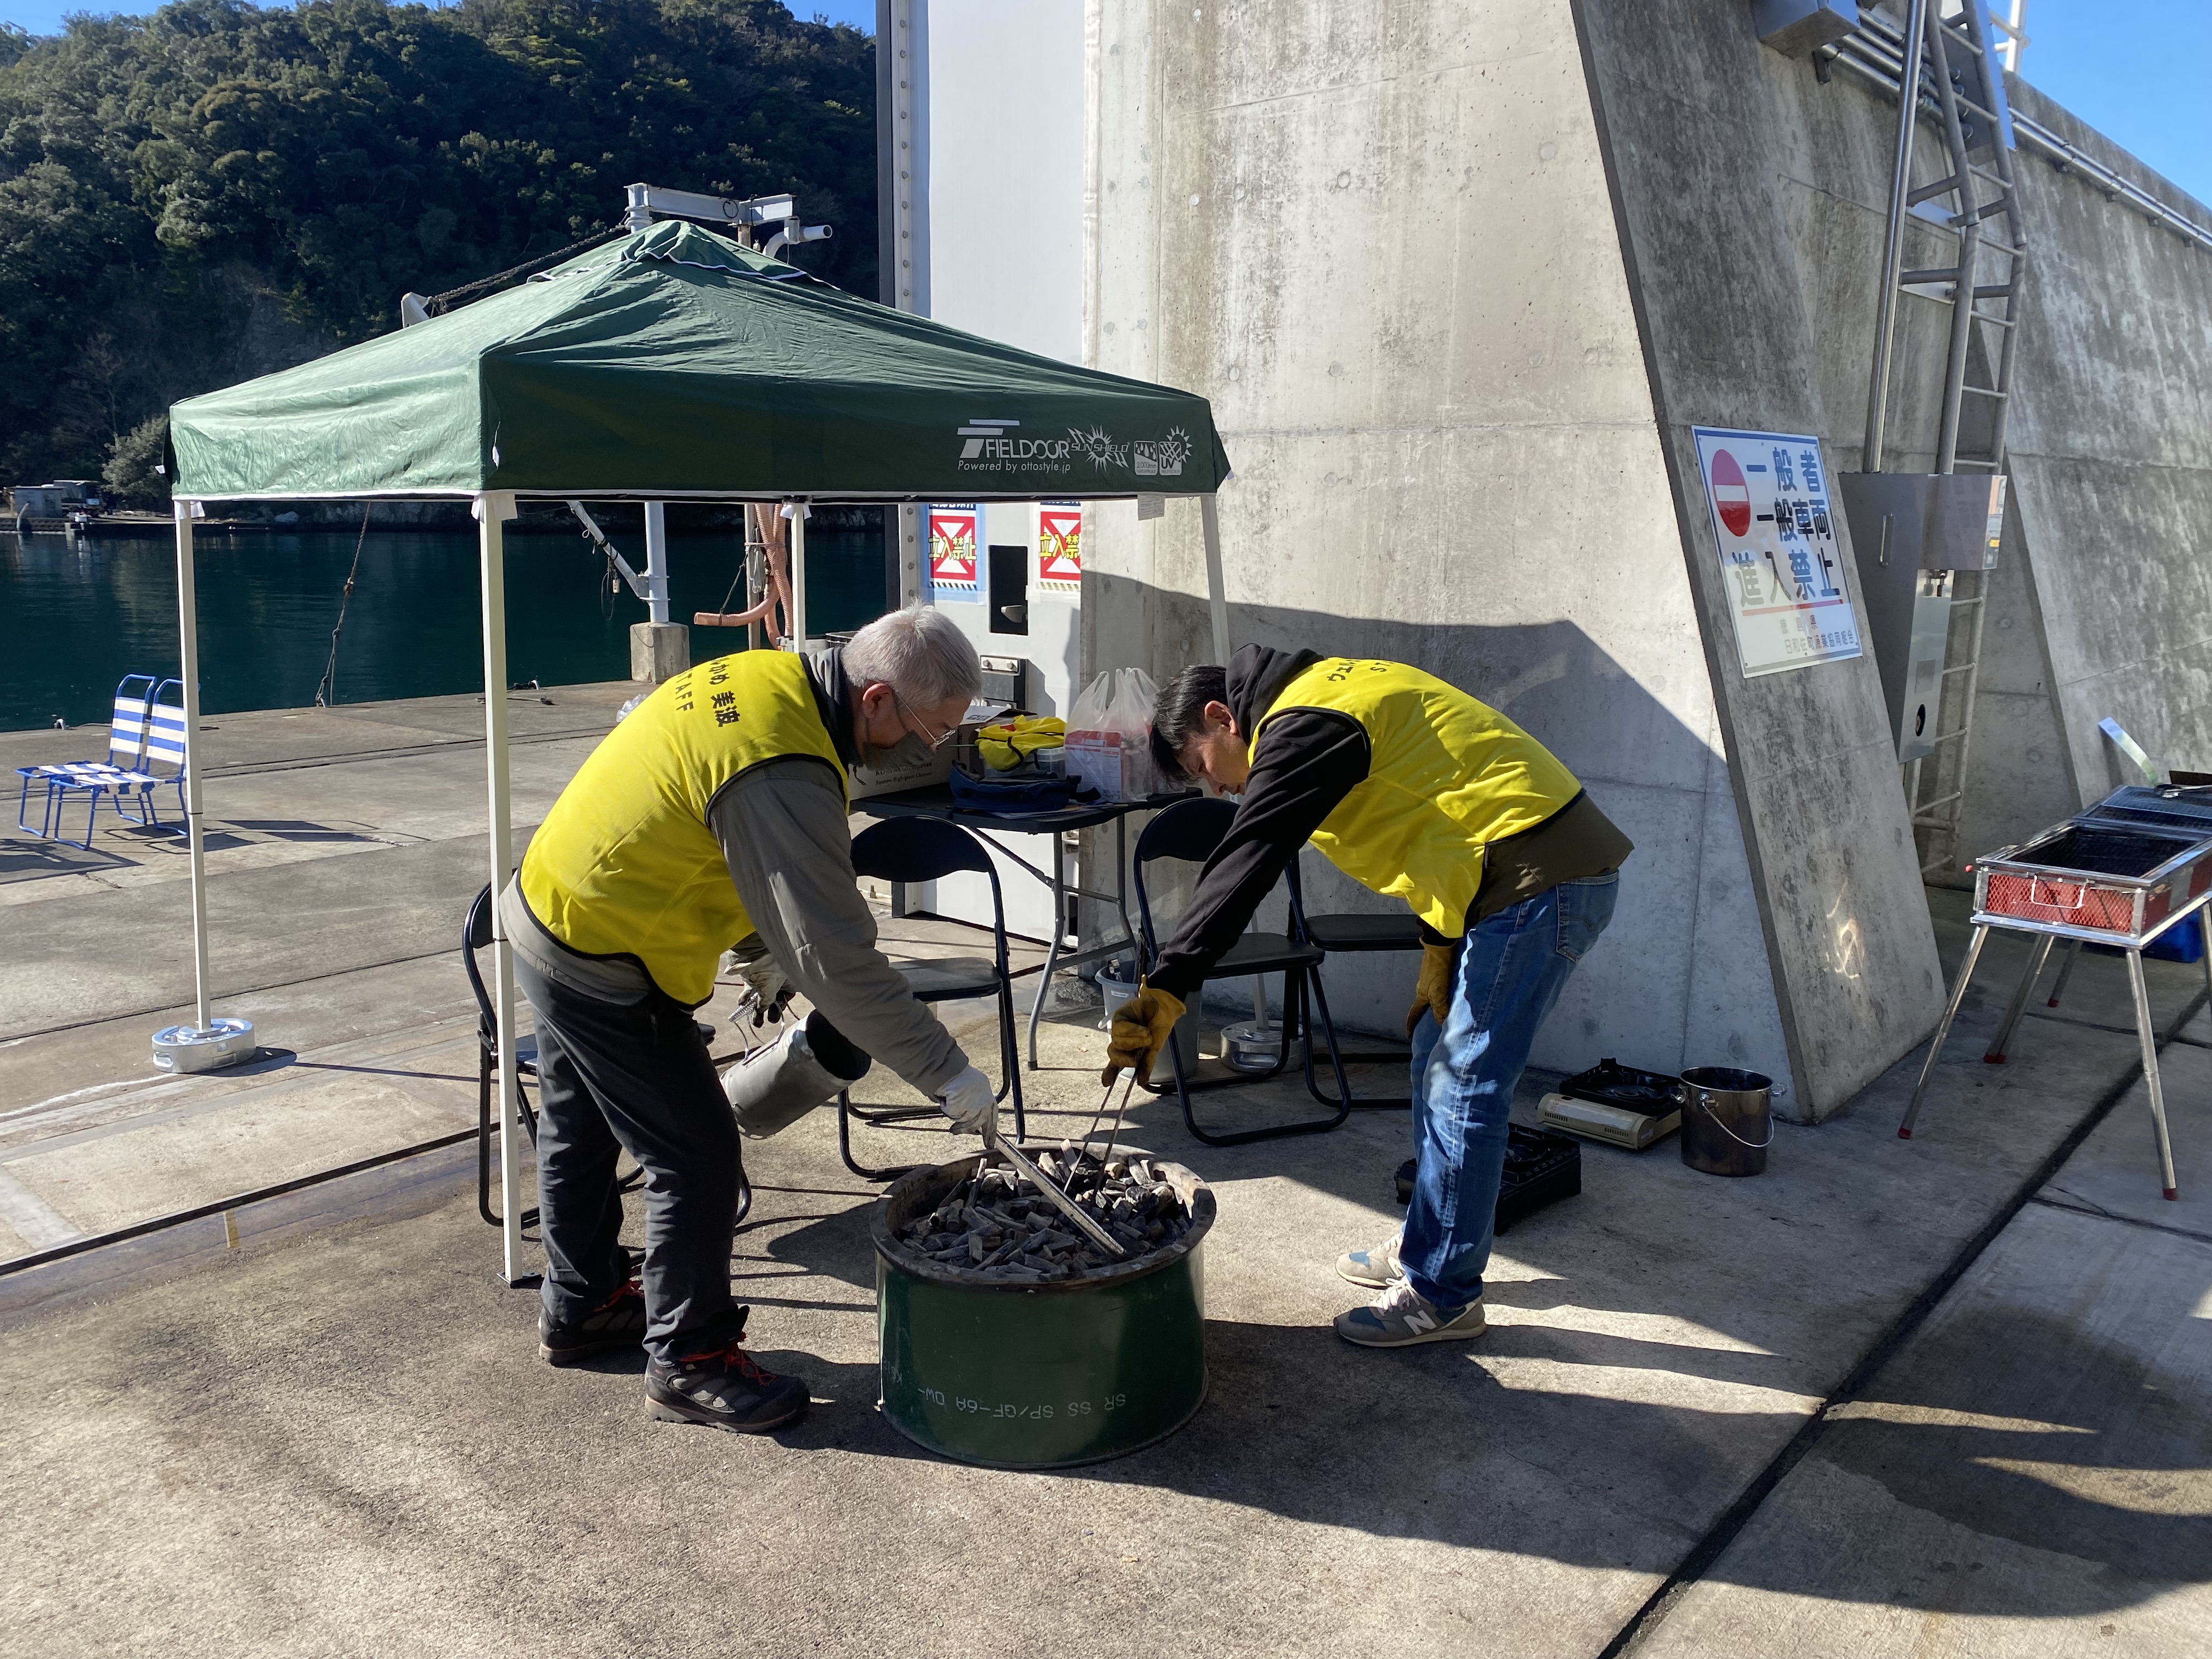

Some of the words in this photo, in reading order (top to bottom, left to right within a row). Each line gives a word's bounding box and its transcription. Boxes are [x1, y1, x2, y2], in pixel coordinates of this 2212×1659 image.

[986, 439, 1070, 460] FIELDOOR
[1161, 456, 1175, 469] UV
[958, 460, 1001, 472] Powered
[1005, 460, 1017, 474] by
[1021, 459, 1071, 475] ottostyle.jp
[1746, 447, 1821, 492] 一般者
[1757, 497, 1831, 542] 一般車両
[928, 534, 977, 561] 立入禁止
[1039, 532, 1081, 560] 立入禁
[1731, 546, 1841, 607] 進入禁止
[675, 669, 694, 712] TAFF
[1068, 1401, 1092, 1417] SS
[1104, 1393, 1126, 1410] SR
